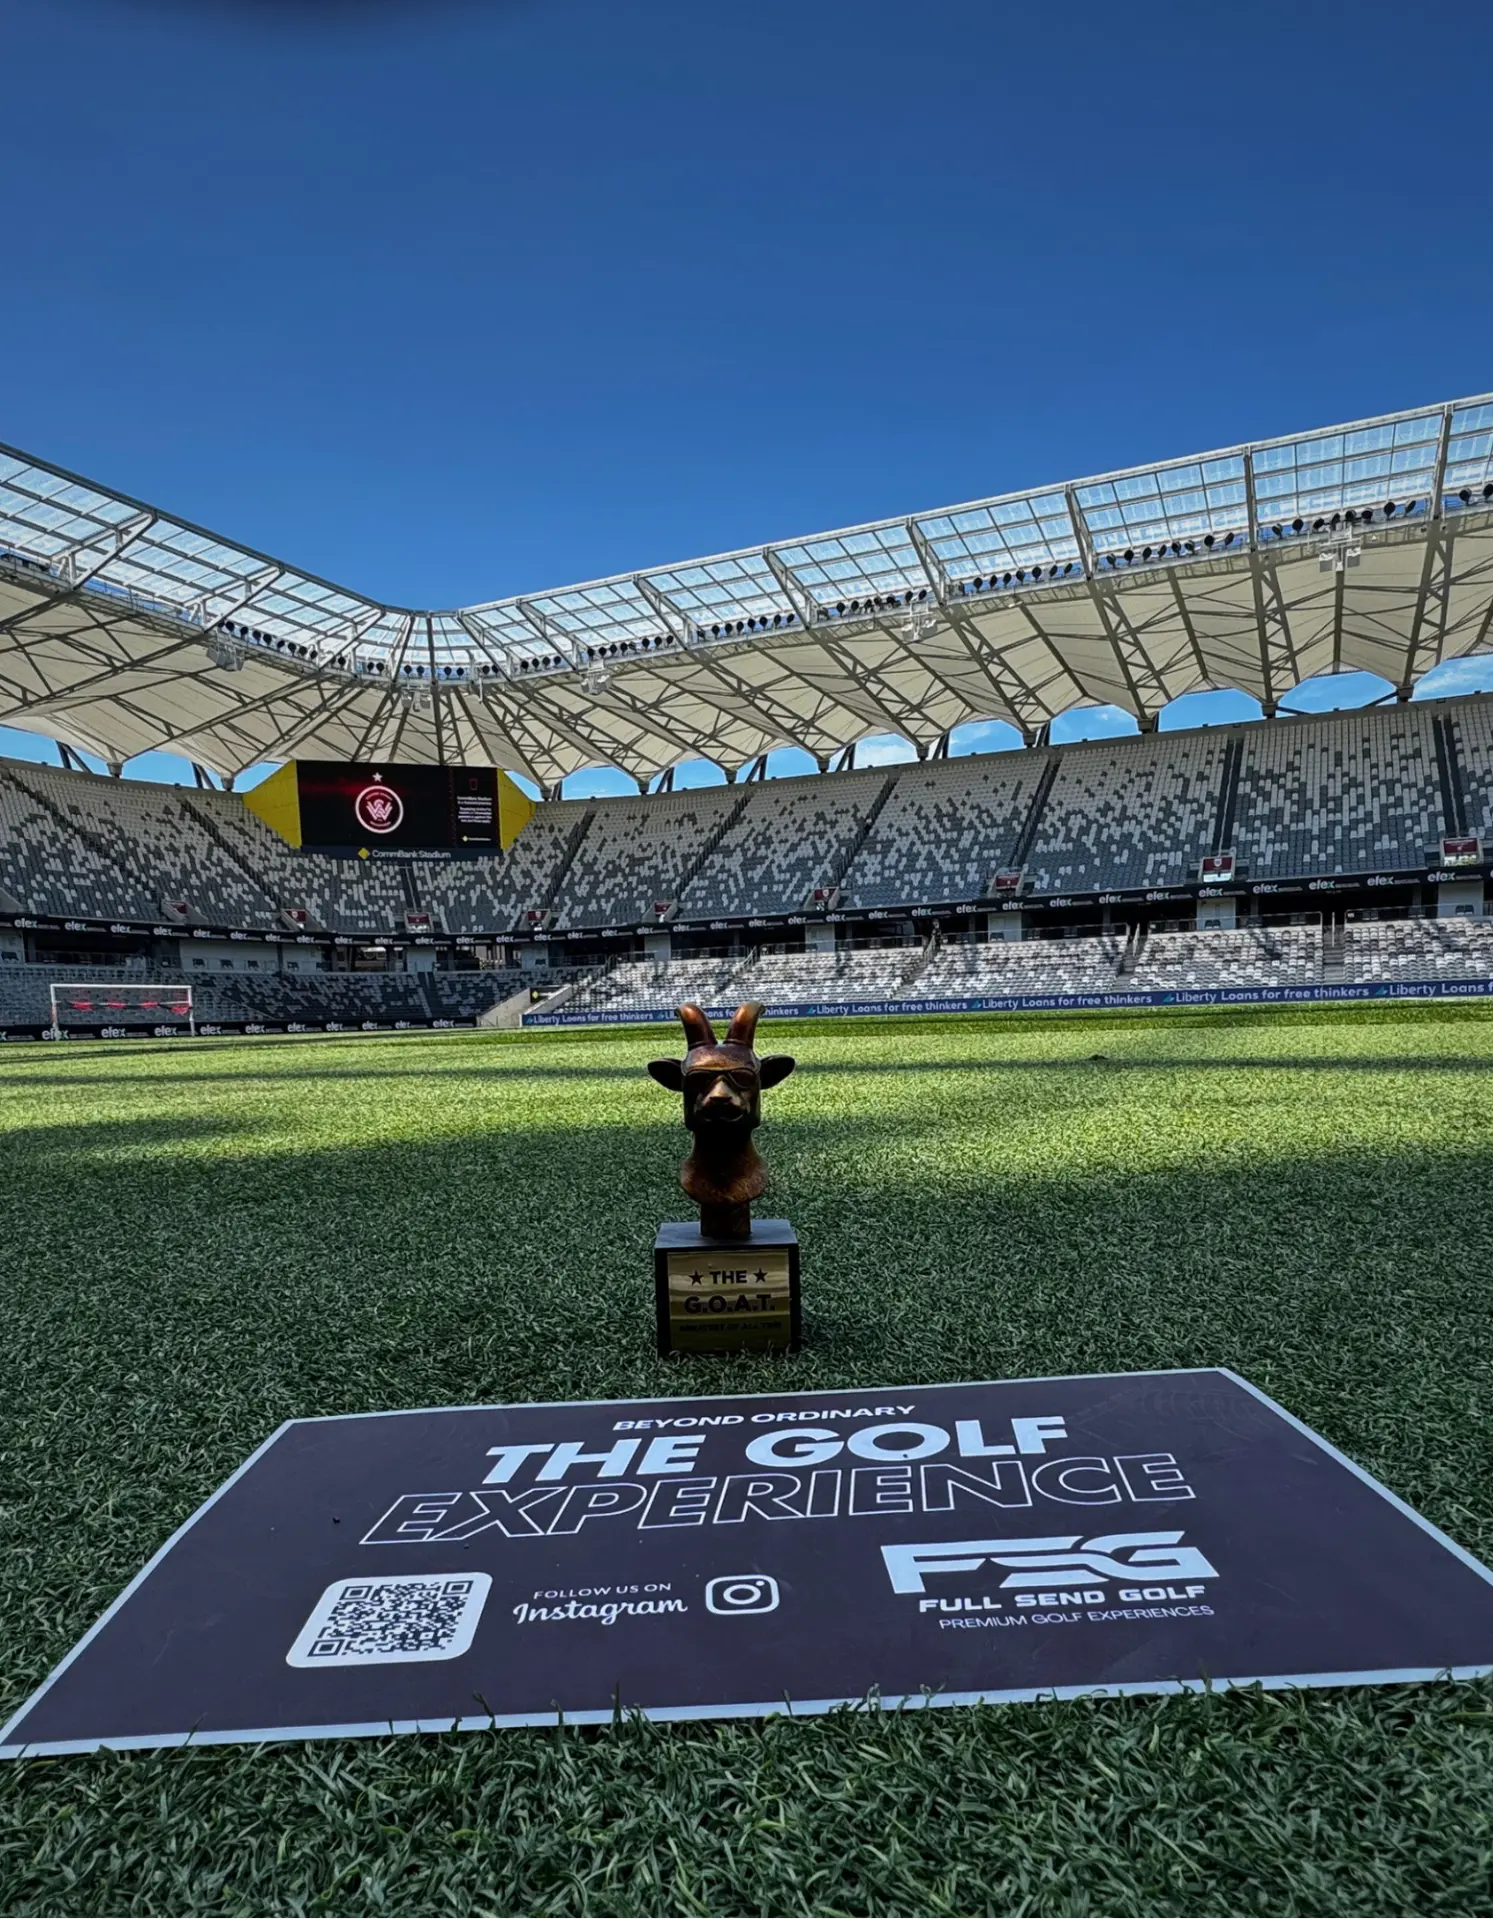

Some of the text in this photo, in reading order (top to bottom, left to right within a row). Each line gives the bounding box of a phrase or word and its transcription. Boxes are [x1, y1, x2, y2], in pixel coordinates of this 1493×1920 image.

[372, 850, 451, 859] CommBank Stadium
[1176, 986, 1369, 1004] Liberty Loans for free thinkers
[1389, 984, 1436, 996] Liberty
[1442, 983, 1484, 994] Loans
[816, 999, 967, 1016] Liberty Loans for free thinkers
[982, 992, 1152, 1011] Liberty Loans for free thinkers
[534, 1010, 653, 1026] Liberty Loans for free thinkers
[707, 1009, 735, 1018] oans fo
[765, 1007, 799, 1016] hinkers
[710, 1270, 747, 1284] THE
[684, 1294, 775, 1314] G.O.A.T.
[613, 1405, 916, 1431] BEYOND ORDINARY
[482, 1416, 1068, 1484] THE GOLF
[358, 1453, 1197, 1545] EXPERIENCE
[880, 1531, 1220, 1594] FSG
[533, 1583, 671, 1599] FOLLOW US ON
[919, 1585, 1206, 1613] FULL SEND GOLF
[513, 1599, 688, 1625] Instagram
[939, 1604, 1215, 1629] PREMIUM GOLF EXPERIENCES
